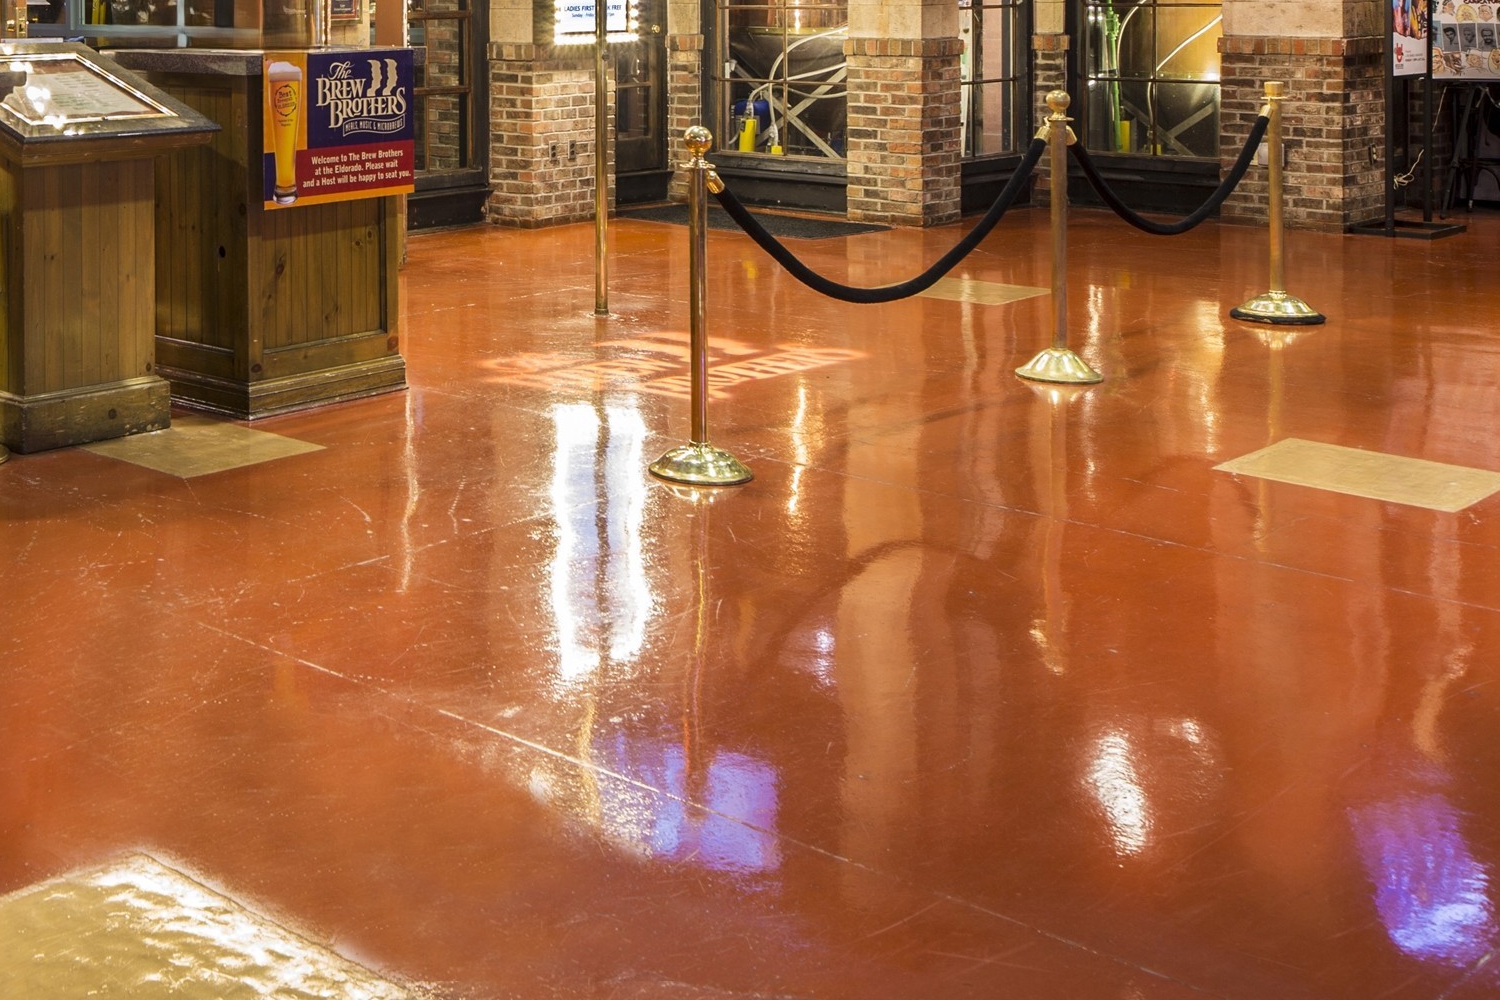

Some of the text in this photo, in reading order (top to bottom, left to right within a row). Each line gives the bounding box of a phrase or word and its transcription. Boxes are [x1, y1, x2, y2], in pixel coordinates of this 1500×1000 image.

[328, 60, 355, 79] The
[316, 75, 366, 109] BREW
[329, 87, 406, 131] BROTHERS
[360, 121, 372, 129] MUSIC
[312, 149, 403, 165] Welcome to The Brew Brothers
[315, 159, 398, 176] at the Eldorado. Please wait
[303, 178, 315, 188] and
[322, 177, 336, 186] Host
[337, 175, 348, 184] will
[350, 174, 357, 183] be
[359, 173, 376, 183] happy
[378, 172, 384, 180] to
[386, 170, 398, 178] seat
[399, 170, 411, 179] you.
